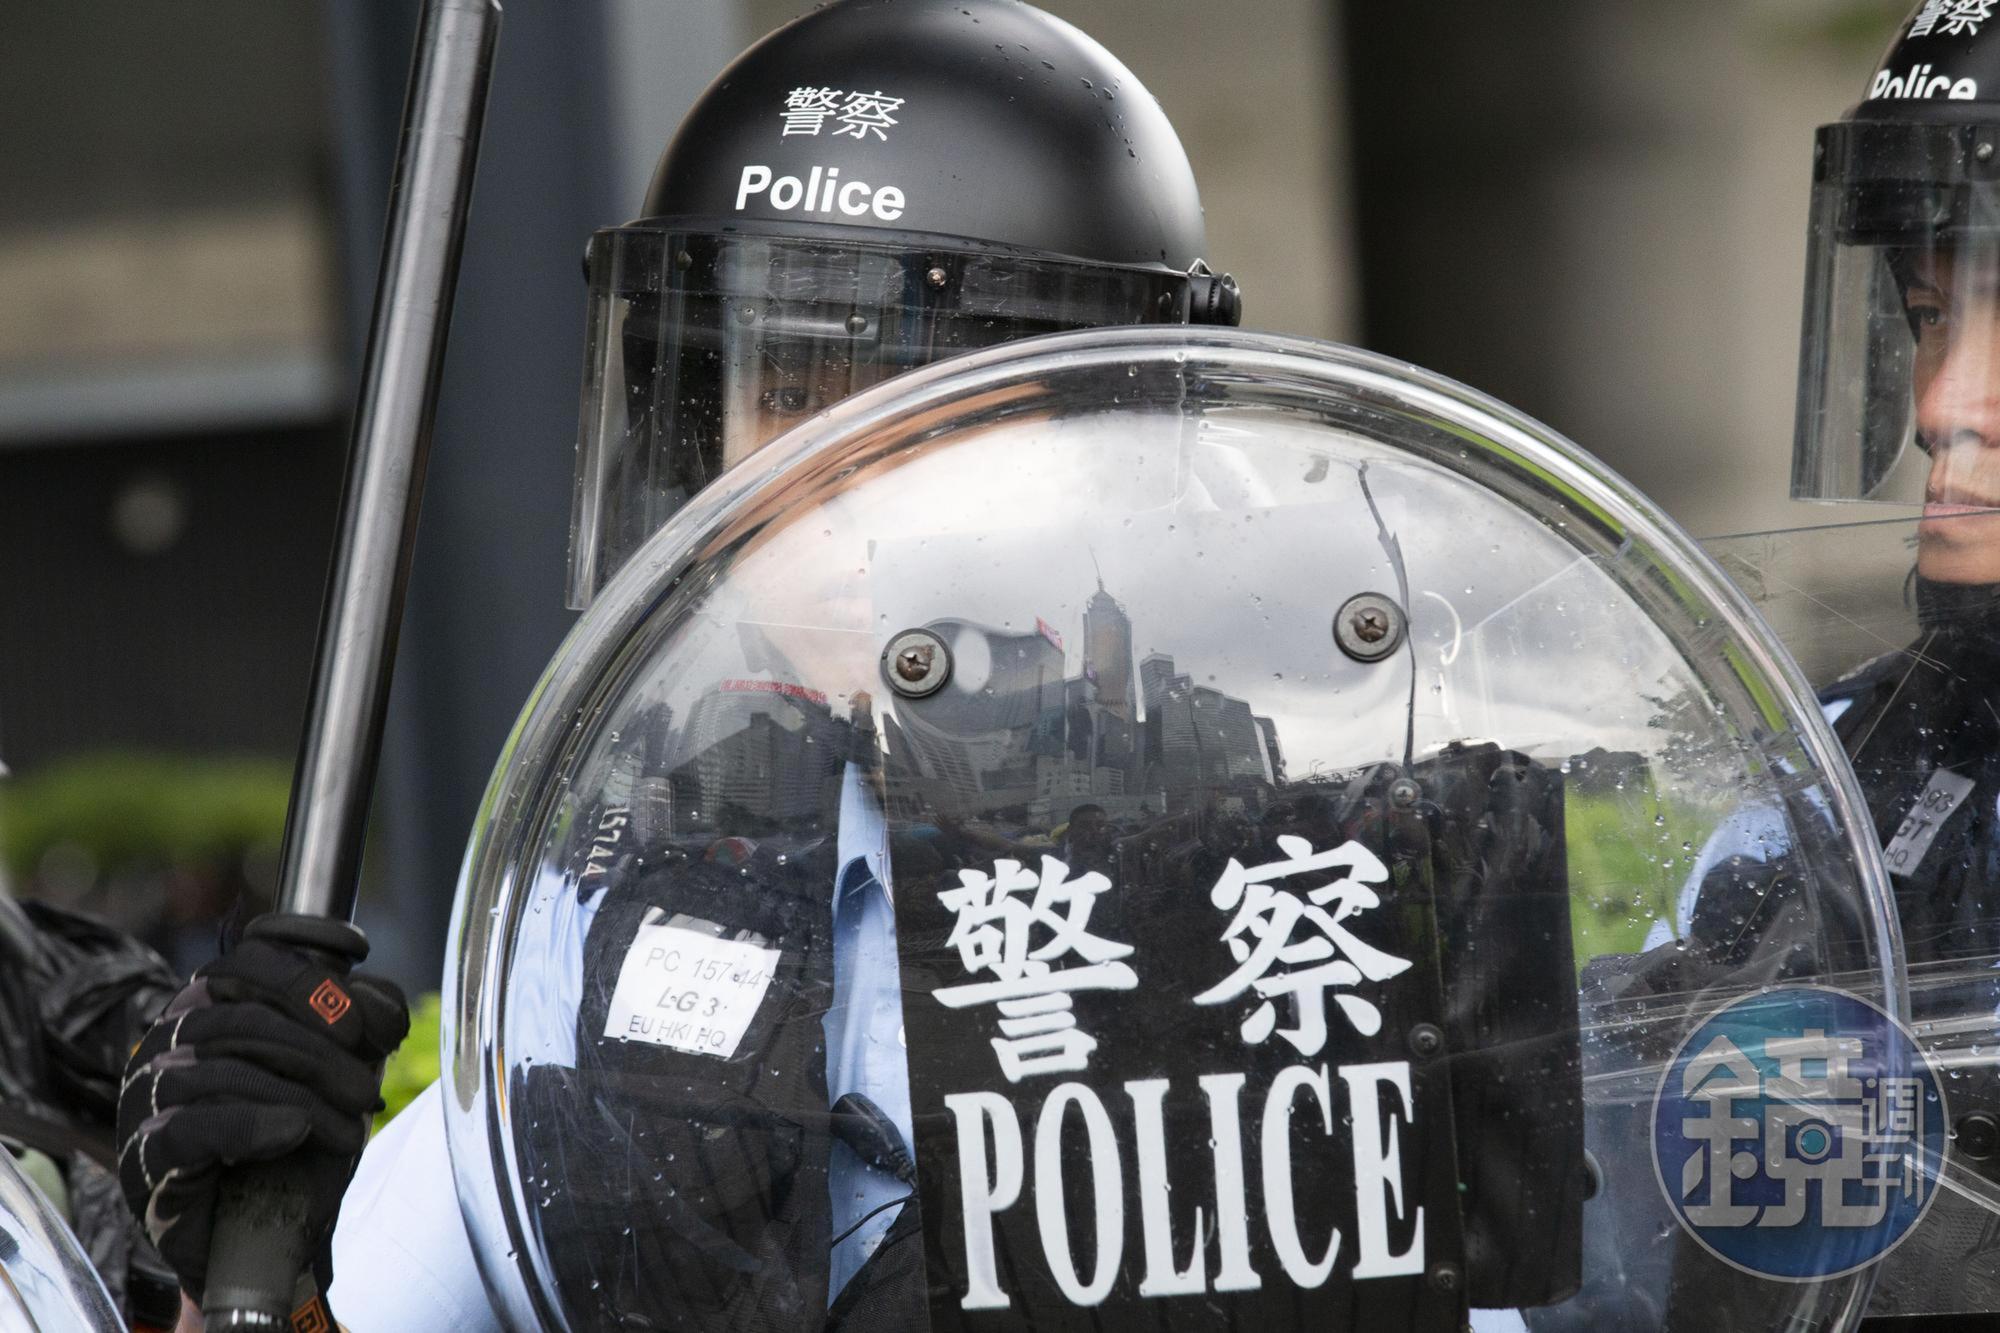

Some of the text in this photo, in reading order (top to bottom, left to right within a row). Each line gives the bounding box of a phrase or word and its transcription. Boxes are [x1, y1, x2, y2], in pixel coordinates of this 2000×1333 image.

[778, 86, 906, 141] 警察
[735, 165, 906, 221] Police
[645, 947, 763, 989] PC 15744
[932, 835, 1413, 1081] 警察
[628, 1014, 655, 1034] EU
[695, 1027, 727, 1049] HQ
[702, 997, 720, 1017] 3
[945, 1061, 1425, 1309] POLICE
